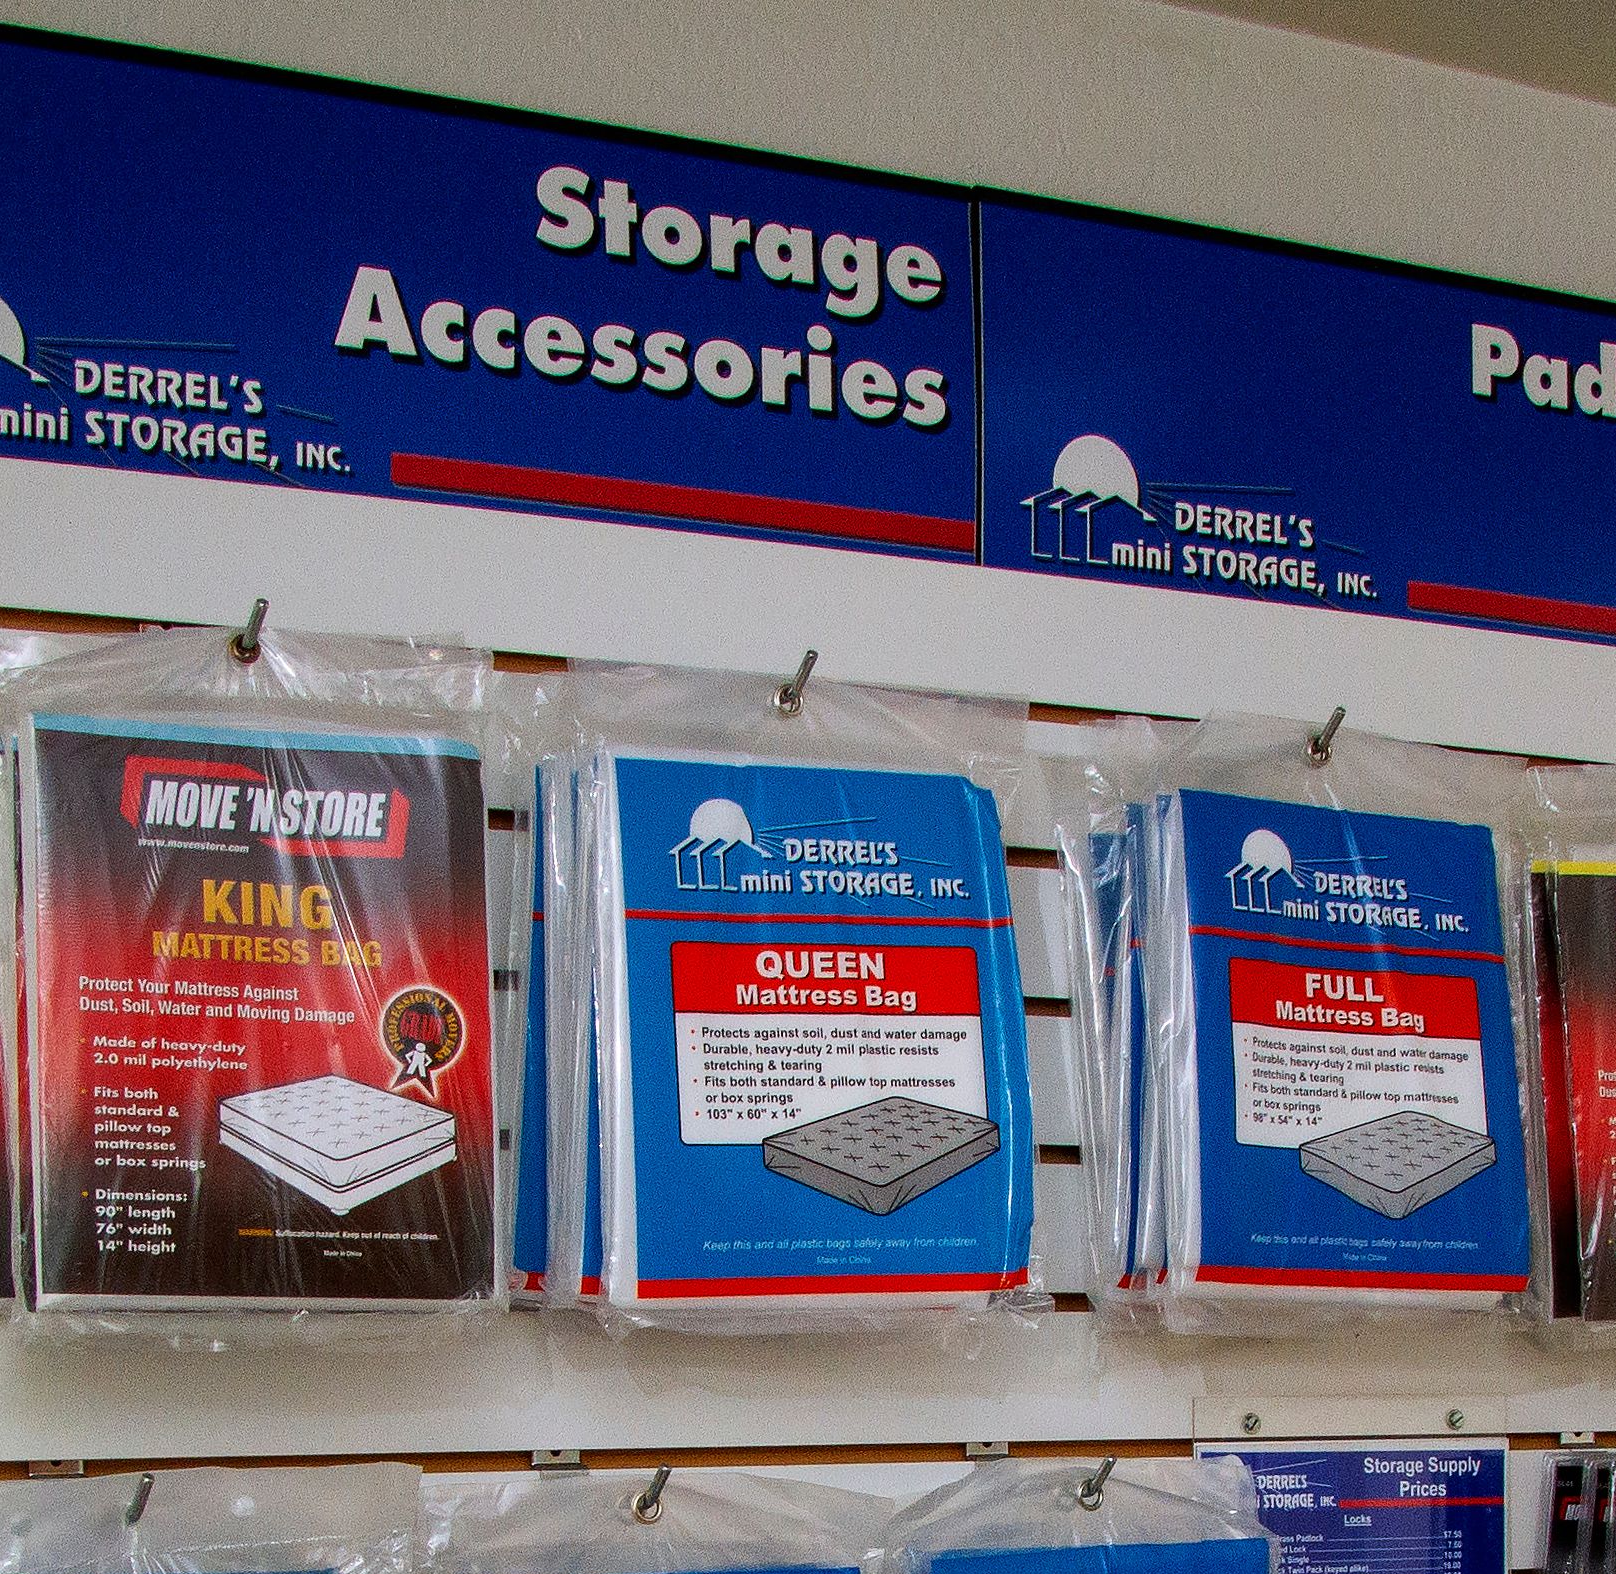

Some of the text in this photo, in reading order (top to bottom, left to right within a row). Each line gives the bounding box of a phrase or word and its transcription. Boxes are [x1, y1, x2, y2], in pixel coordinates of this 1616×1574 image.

[536, 166, 944, 318] Storage
[332, 266, 948, 427] Accessories
[74, 361, 262, 413] DERREL'S
[85, 409, 281, 469] STORAGE,
[296, 441, 350, 474] INC.
[1175, 502, 1314, 547] DERREL'S
[1112, 538, 1376, 598] mini STORAGE, INC.
[145, 779, 239, 830] MOVE
[279, 789, 388, 837] STORE
[138, 837, 249, 854] www.movenstore.com
[785, 838, 899, 866] DERREL'S
[741, 871, 792, 893] mini
[931, 878, 970, 898] INC.
[1313, 871, 1408, 900] DERREL'S
[202, 879, 335, 929] KING
[1283, 901, 1320, 922] mini
[1436, 913, 1469, 933] INC.
[152, 930, 382, 968] MATTRESS BAG
[755, 952, 885, 980] QUEEN
[79, 976, 299, 1001] Protect Your Mattress Against
[736, 985, 917, 1011] Mattress Bag
[1305, 973, 1384, 1003] FULL
[79, 997, 355, 1023] Dust, Soil, Water and Moving Damage
[1276, 1001, 1424, 1033] Mattress Bag
[702, 1027, 967, 1041] Protects against soil, dust and water damage
[95, 1189, 188, 1202] Dimensions:
[128, 1206, 175, 1220] length
[129, 1224, 172, 1235] width
[129, 1240, 176, 1255] height
[1364, 1457, 1481, 1477] Storage Supply
[1400, 1481, 1447, 1496] Prices
[1344, 1515, 1371, 1525] Locks
